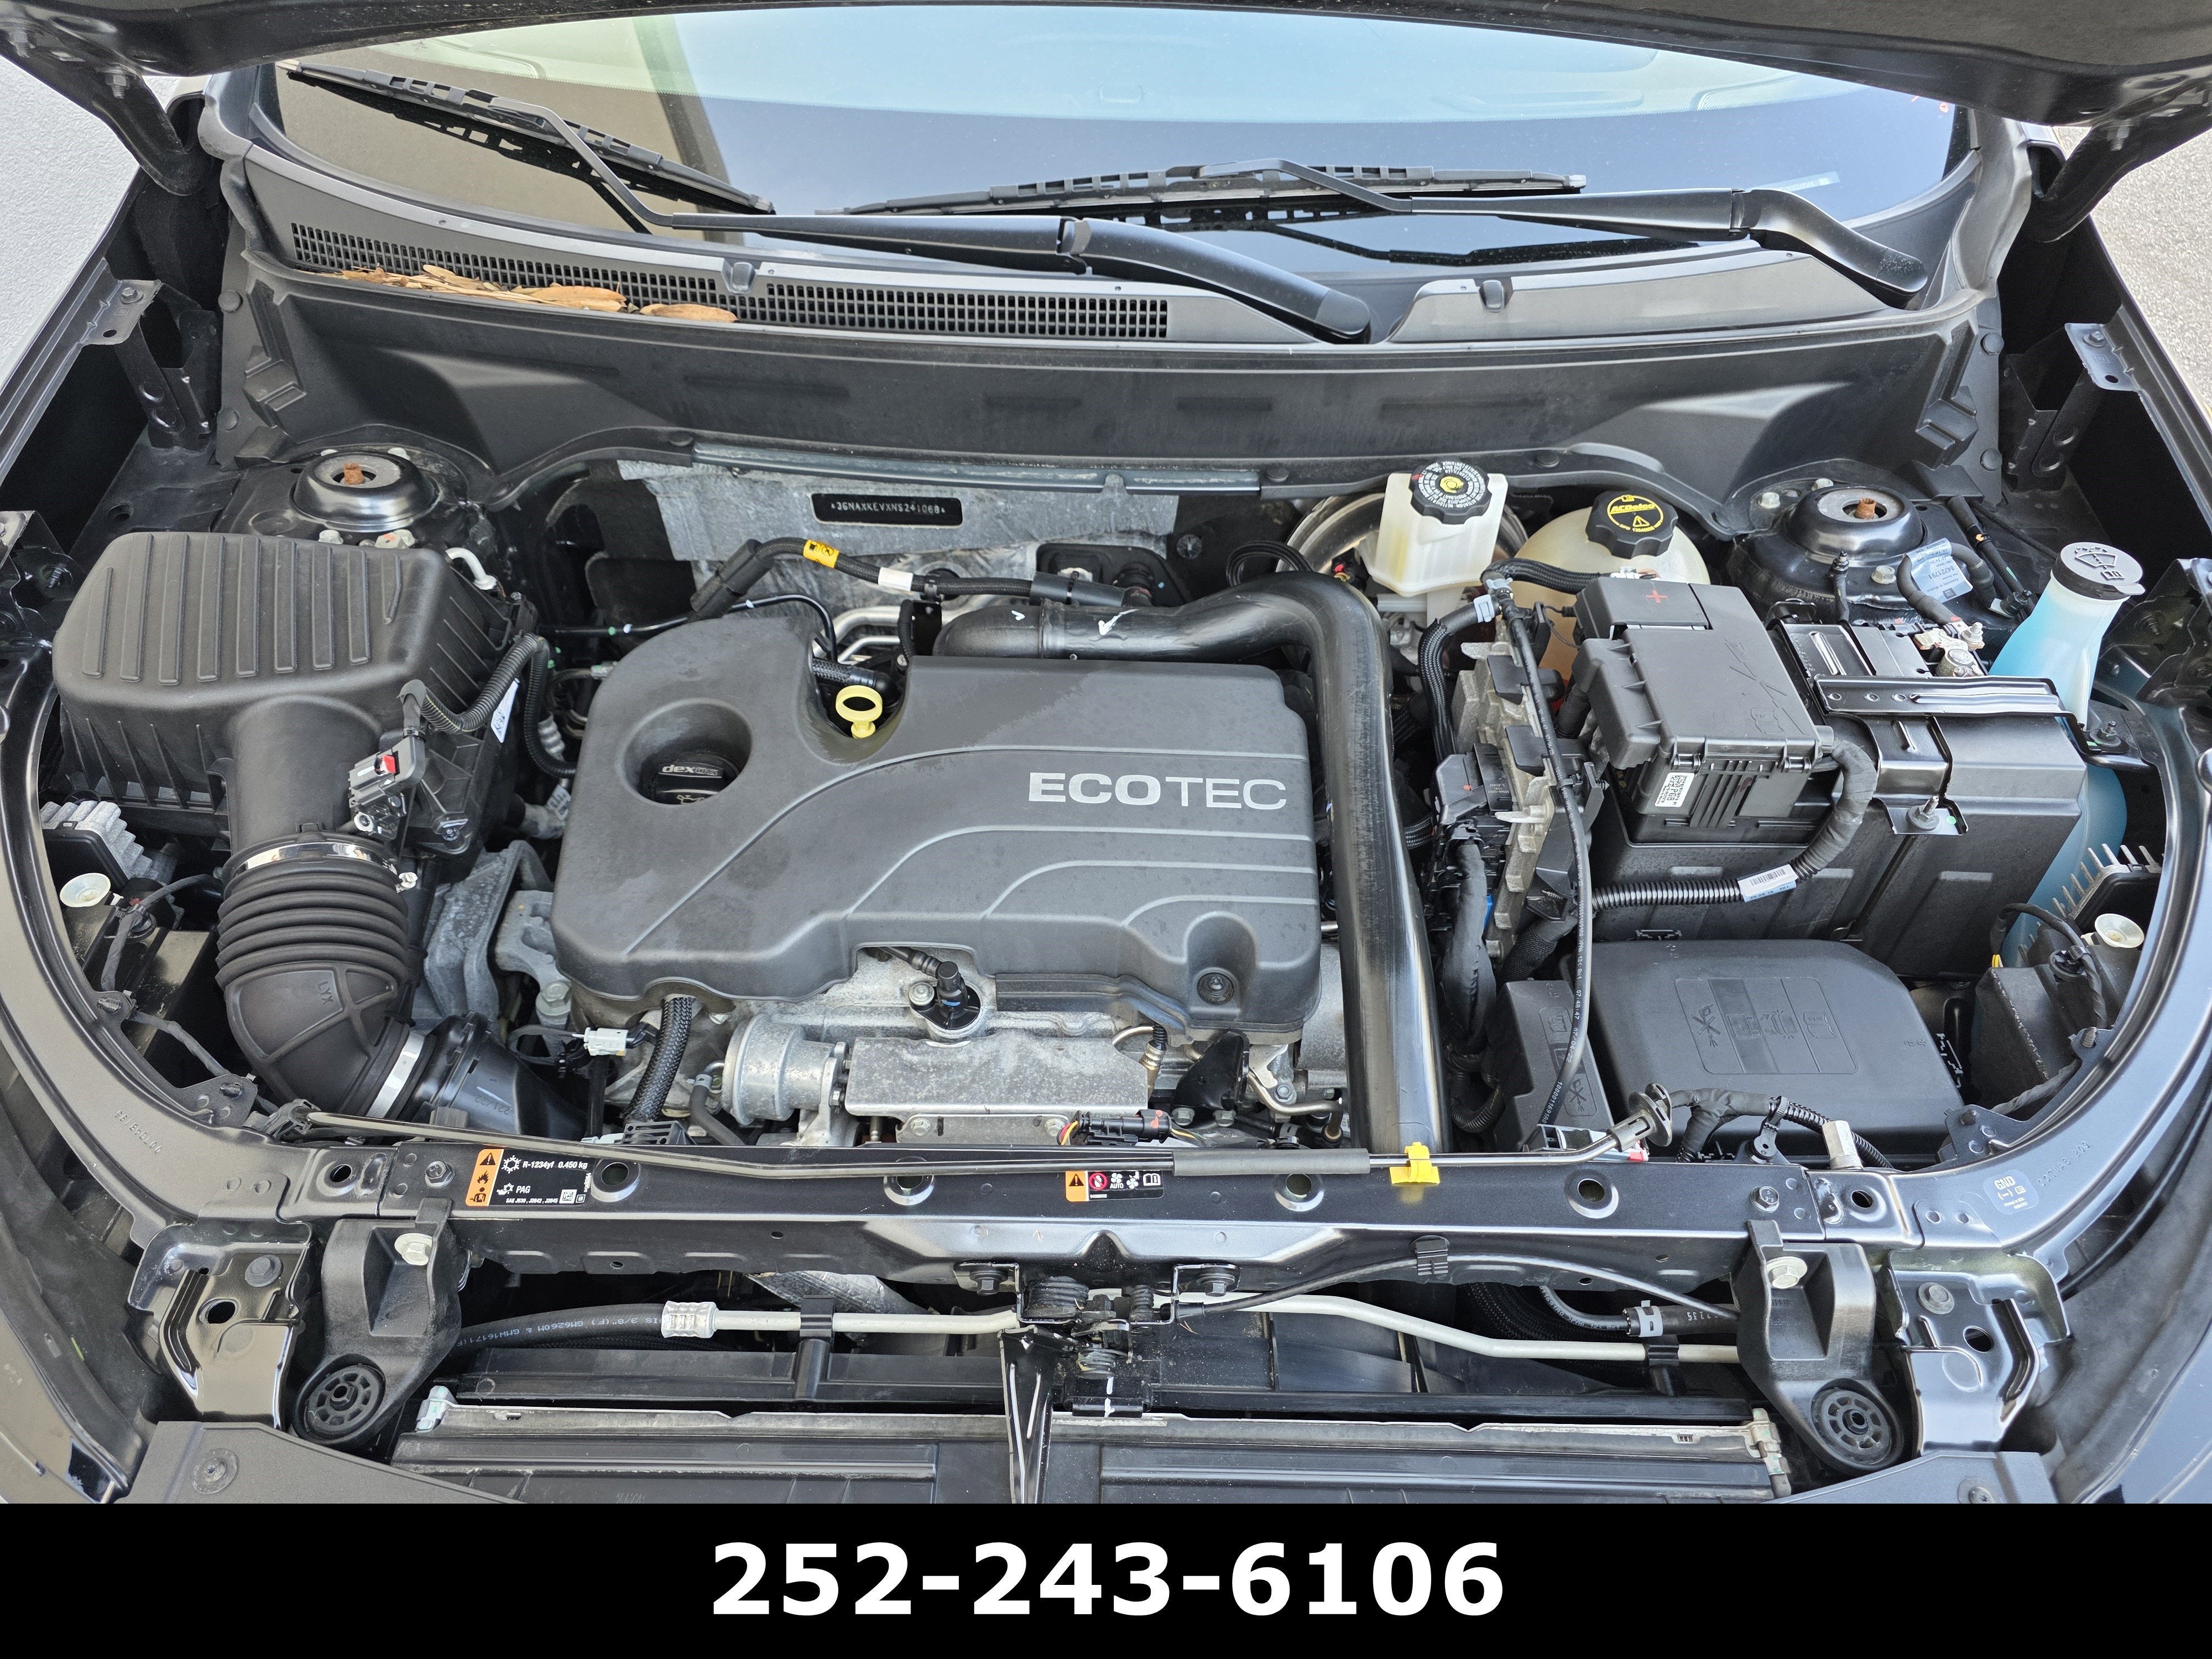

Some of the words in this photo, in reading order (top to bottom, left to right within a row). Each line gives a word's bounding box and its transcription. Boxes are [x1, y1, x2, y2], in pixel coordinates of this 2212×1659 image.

[1928, 566, 1955, 580] 84221791
[662, 764, 719, 776] dexos
[1029, 772, 1287, 810] ECOTEC
[317, 981, 334, 1006] LYX
[1566, 1027, 1578, 1063] 07/04/22
[523, 1161, 555, 1170] R-1234yf
[578, 1162, 587, 1170] kg
[1994, 1176, 2016, 1190] GND
[538, 1320, 584, 1332] GM6260M
